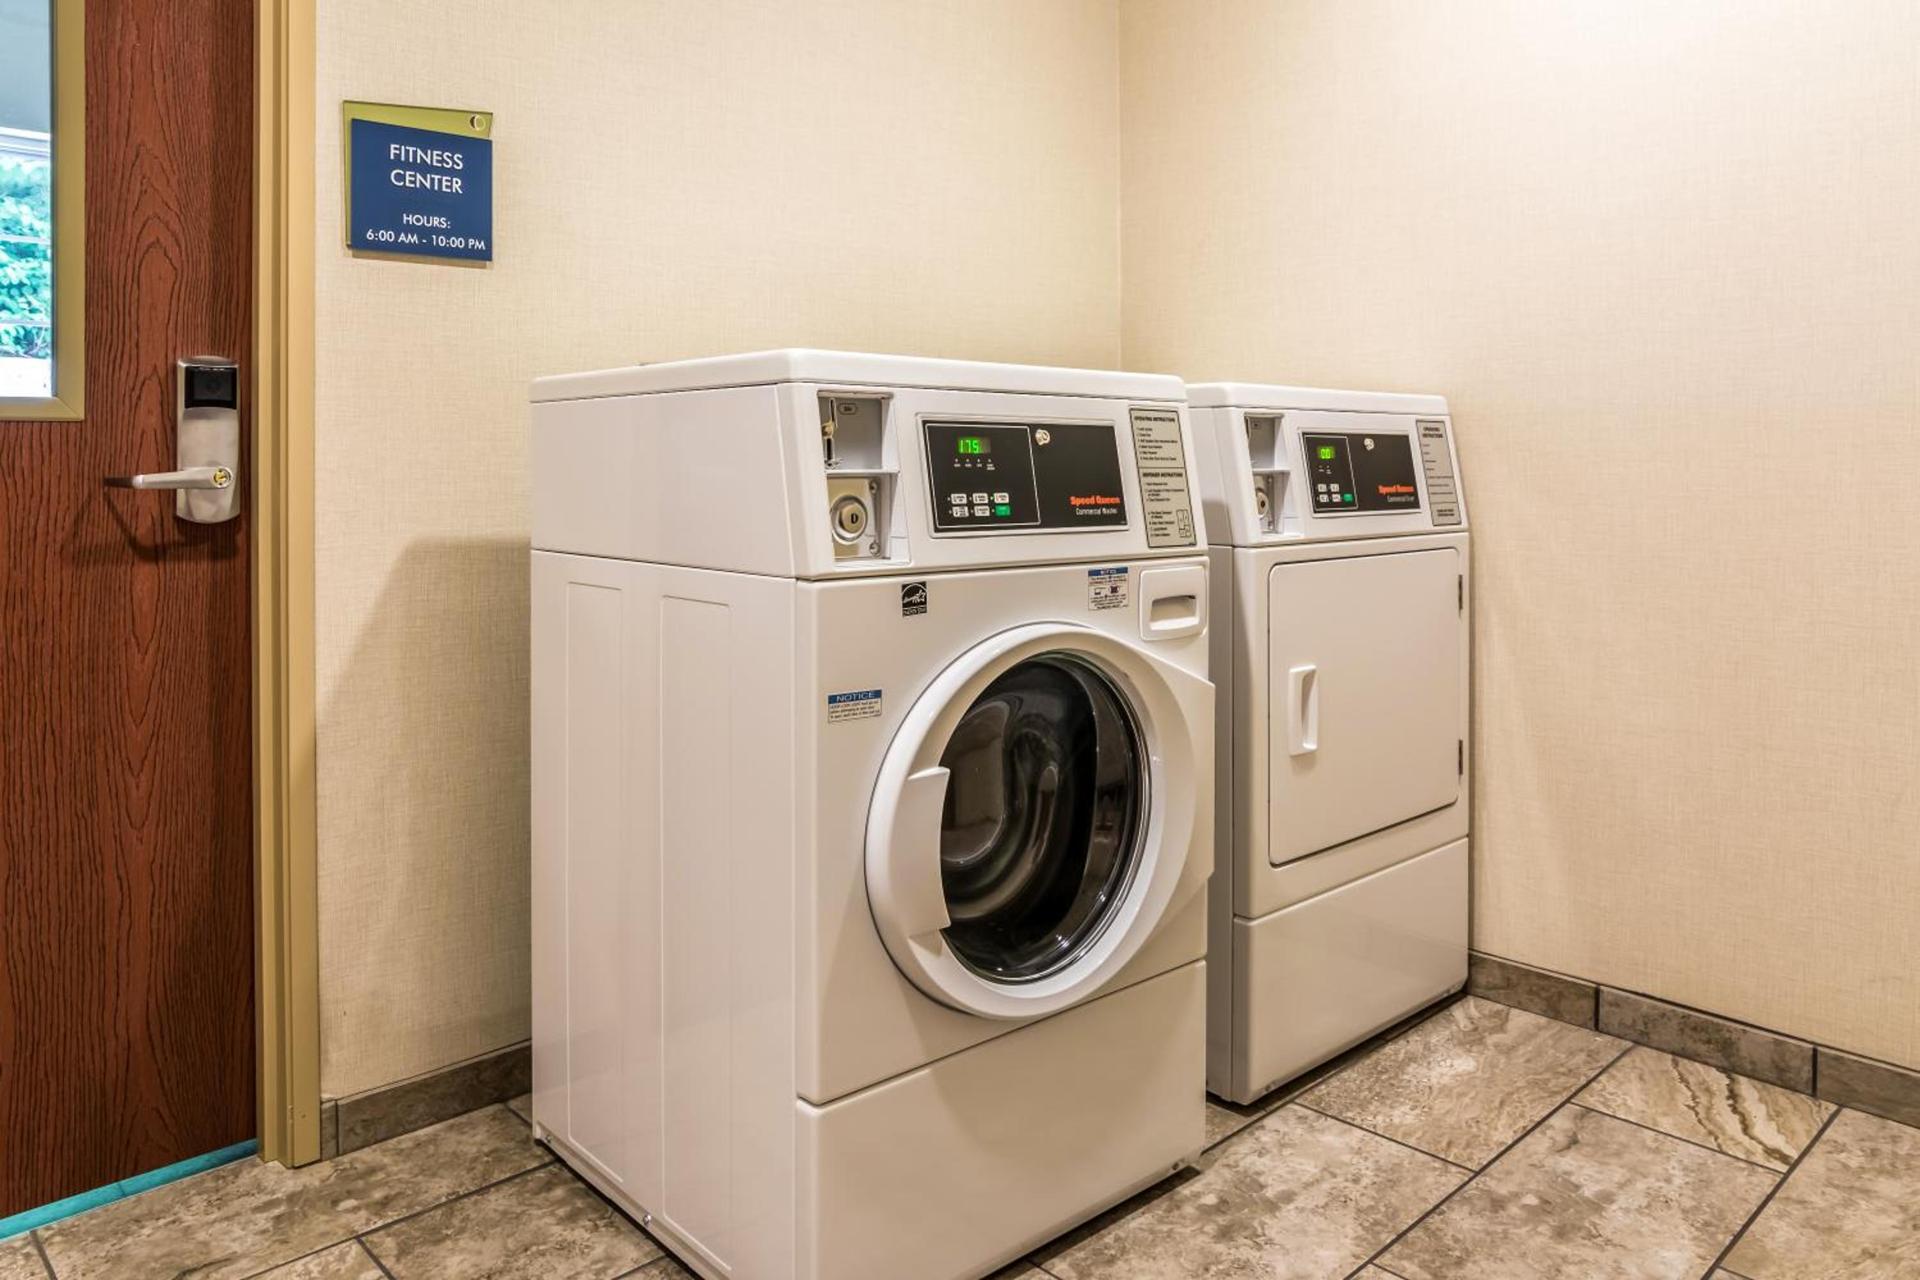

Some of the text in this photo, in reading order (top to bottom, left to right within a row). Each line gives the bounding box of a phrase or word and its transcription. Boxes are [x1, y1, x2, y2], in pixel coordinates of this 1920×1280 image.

[389, 143, 464, 170] FITNESS
[390, 169, 463, 194] CENTER
[402, 213, 451, 229] HOURS:
[366, 228, 395, 243] 6:00
[397, 232, 419, 245] AM
[431, 235, 465, 249] 10:00
[467, 238, 486, 250] PM
[1070, 495, 1121, 506] Speed Queen
[836, 692, 875, 701] NOTICE
